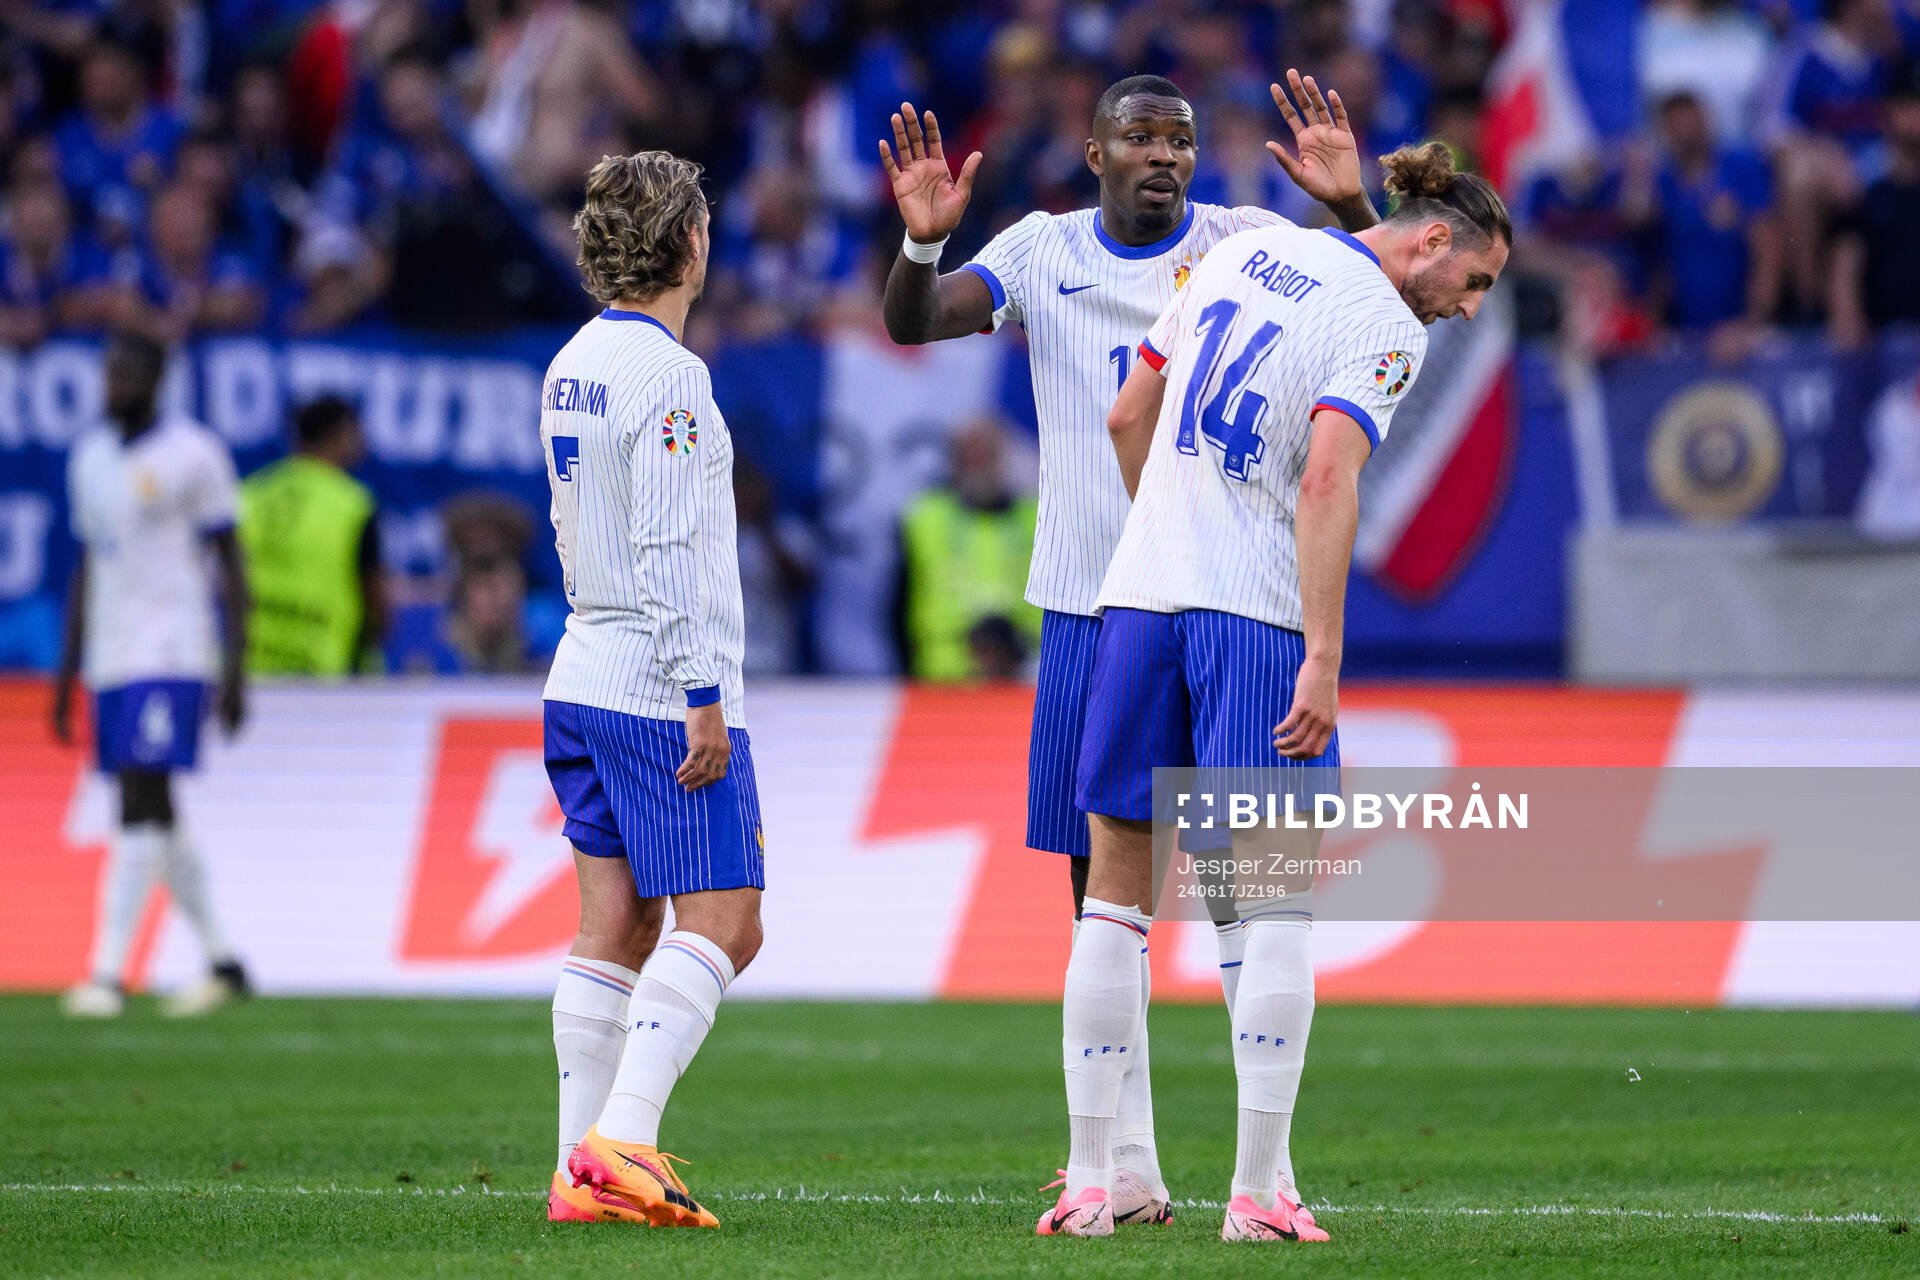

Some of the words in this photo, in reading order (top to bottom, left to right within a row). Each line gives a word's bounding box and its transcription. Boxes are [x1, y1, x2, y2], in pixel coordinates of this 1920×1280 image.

[1240, 249, 1322, 303] RABIOT
[1109, 345, 1140, 395] 1
[1176, 297, 1285, 482] 14
